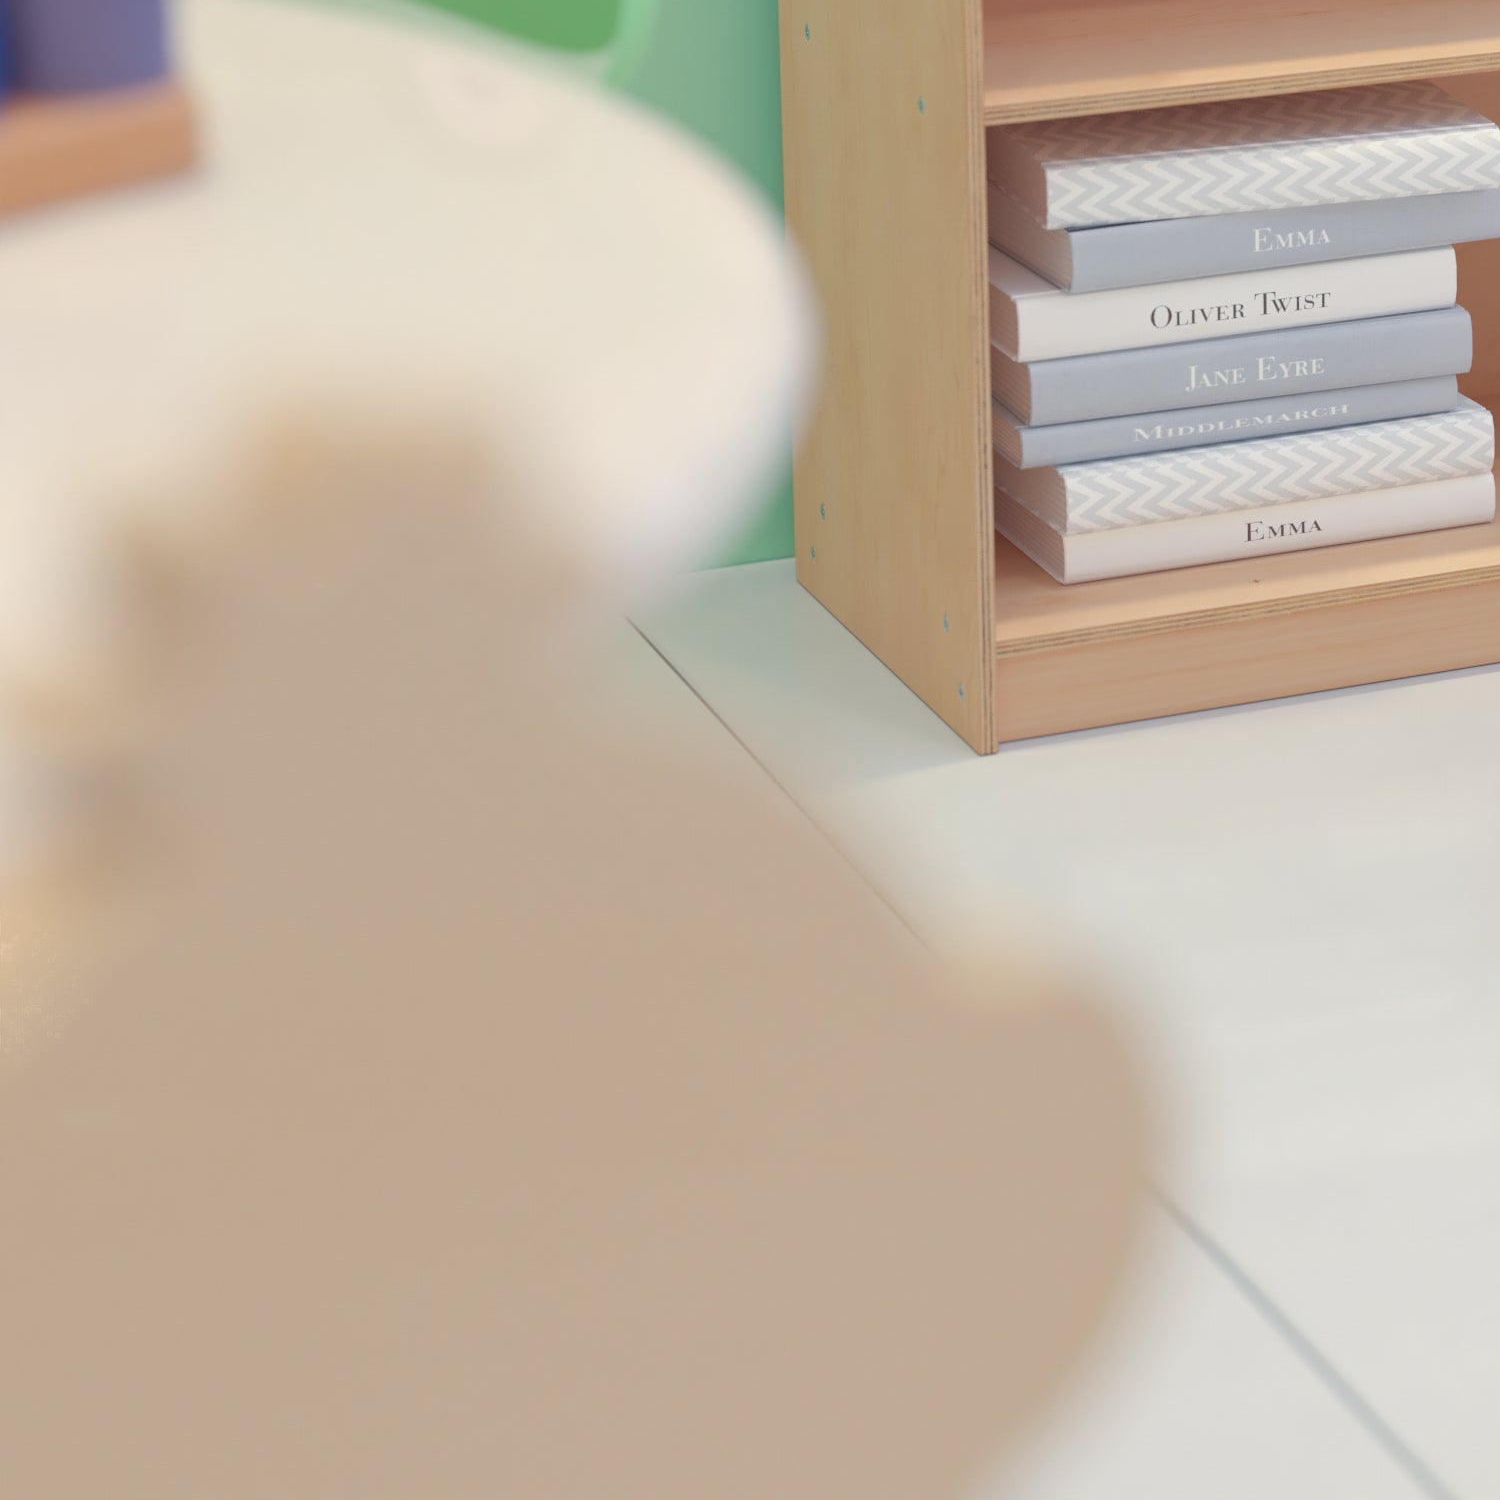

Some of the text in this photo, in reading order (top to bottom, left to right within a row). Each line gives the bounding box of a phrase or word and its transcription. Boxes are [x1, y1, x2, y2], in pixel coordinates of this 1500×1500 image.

[1252, 227, 1332, 253] EMMA
[1149, 290, 1332, 329] OLIVER TWIST
[1185, 355, 1326, 392] JANE EYRE
[1133, 404, 1350, 442] MIDDLEMARCH
[1243, 520, 1324, 543] EMMA
